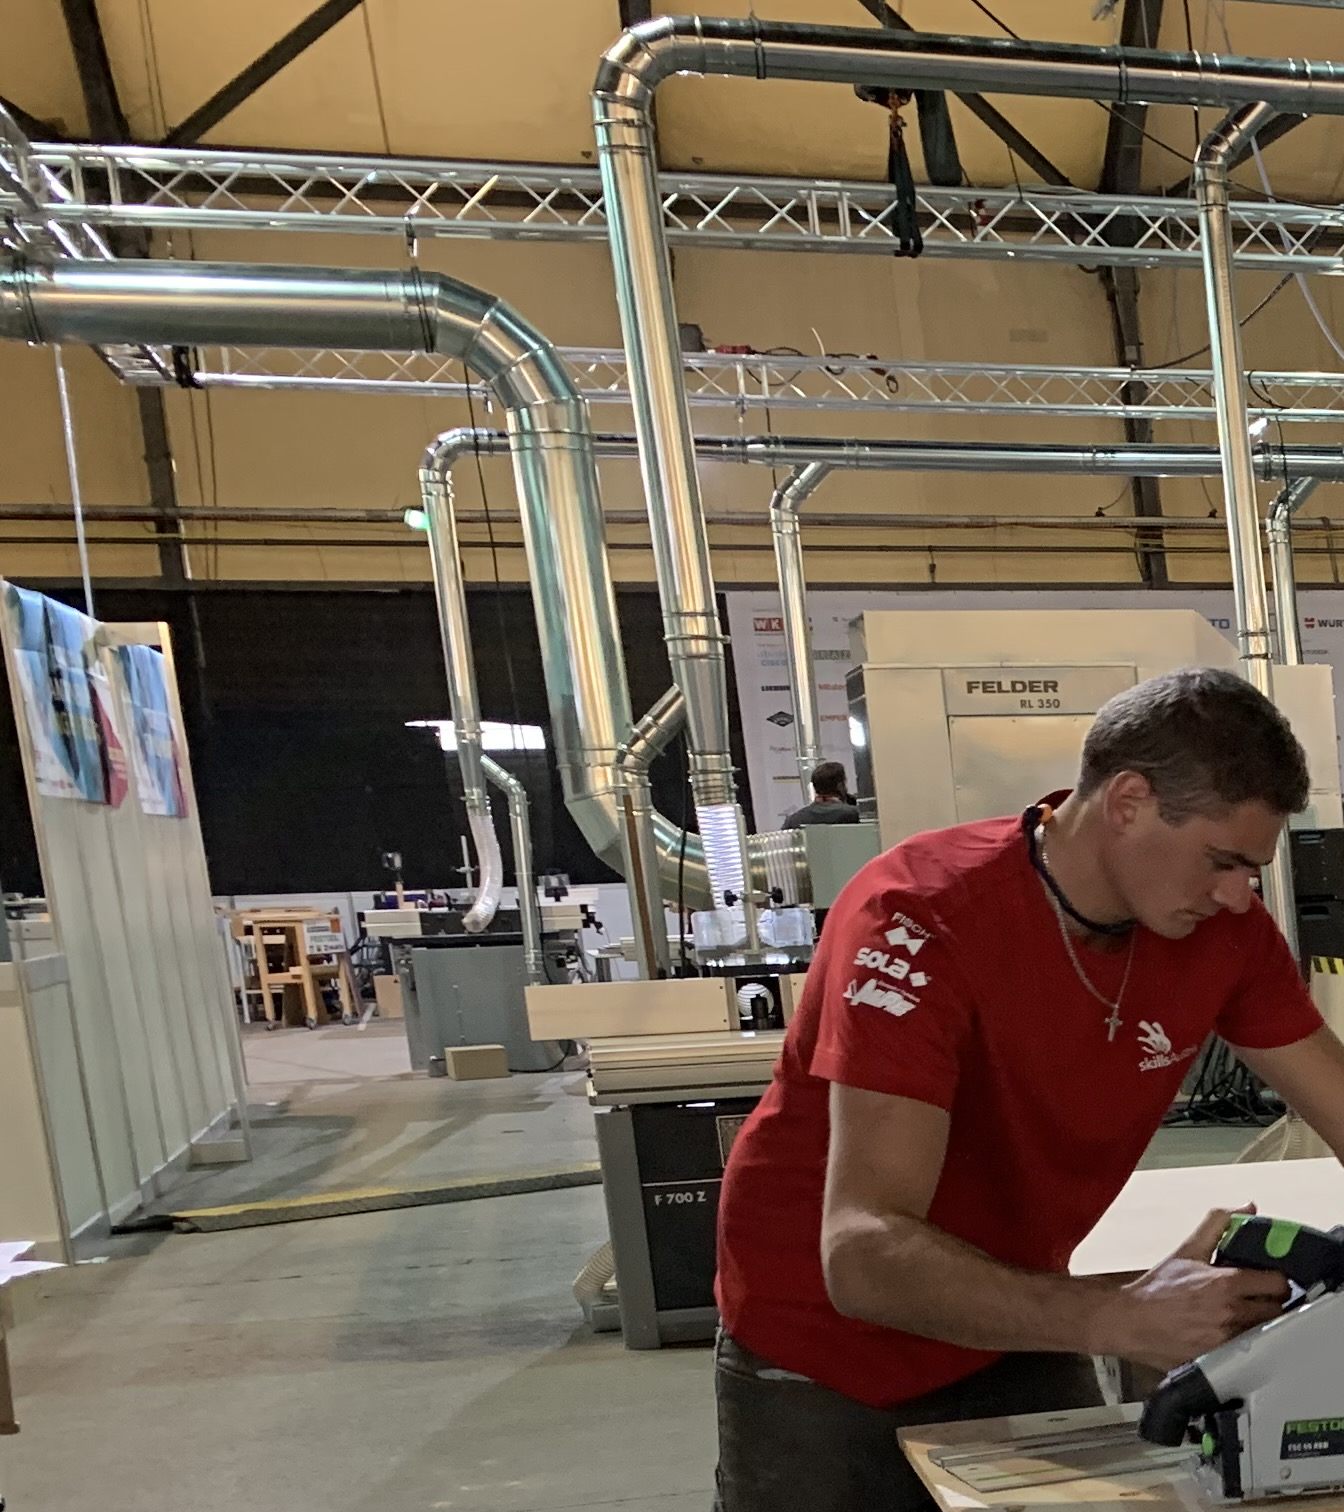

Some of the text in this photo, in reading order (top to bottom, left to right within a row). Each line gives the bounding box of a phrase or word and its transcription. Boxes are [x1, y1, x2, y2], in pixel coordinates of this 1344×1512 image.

[966, 680, 1059, 694] FELDER
[1019, 698, 1061, 709] RL 350
[666, 1191, 695, 1204] 700
